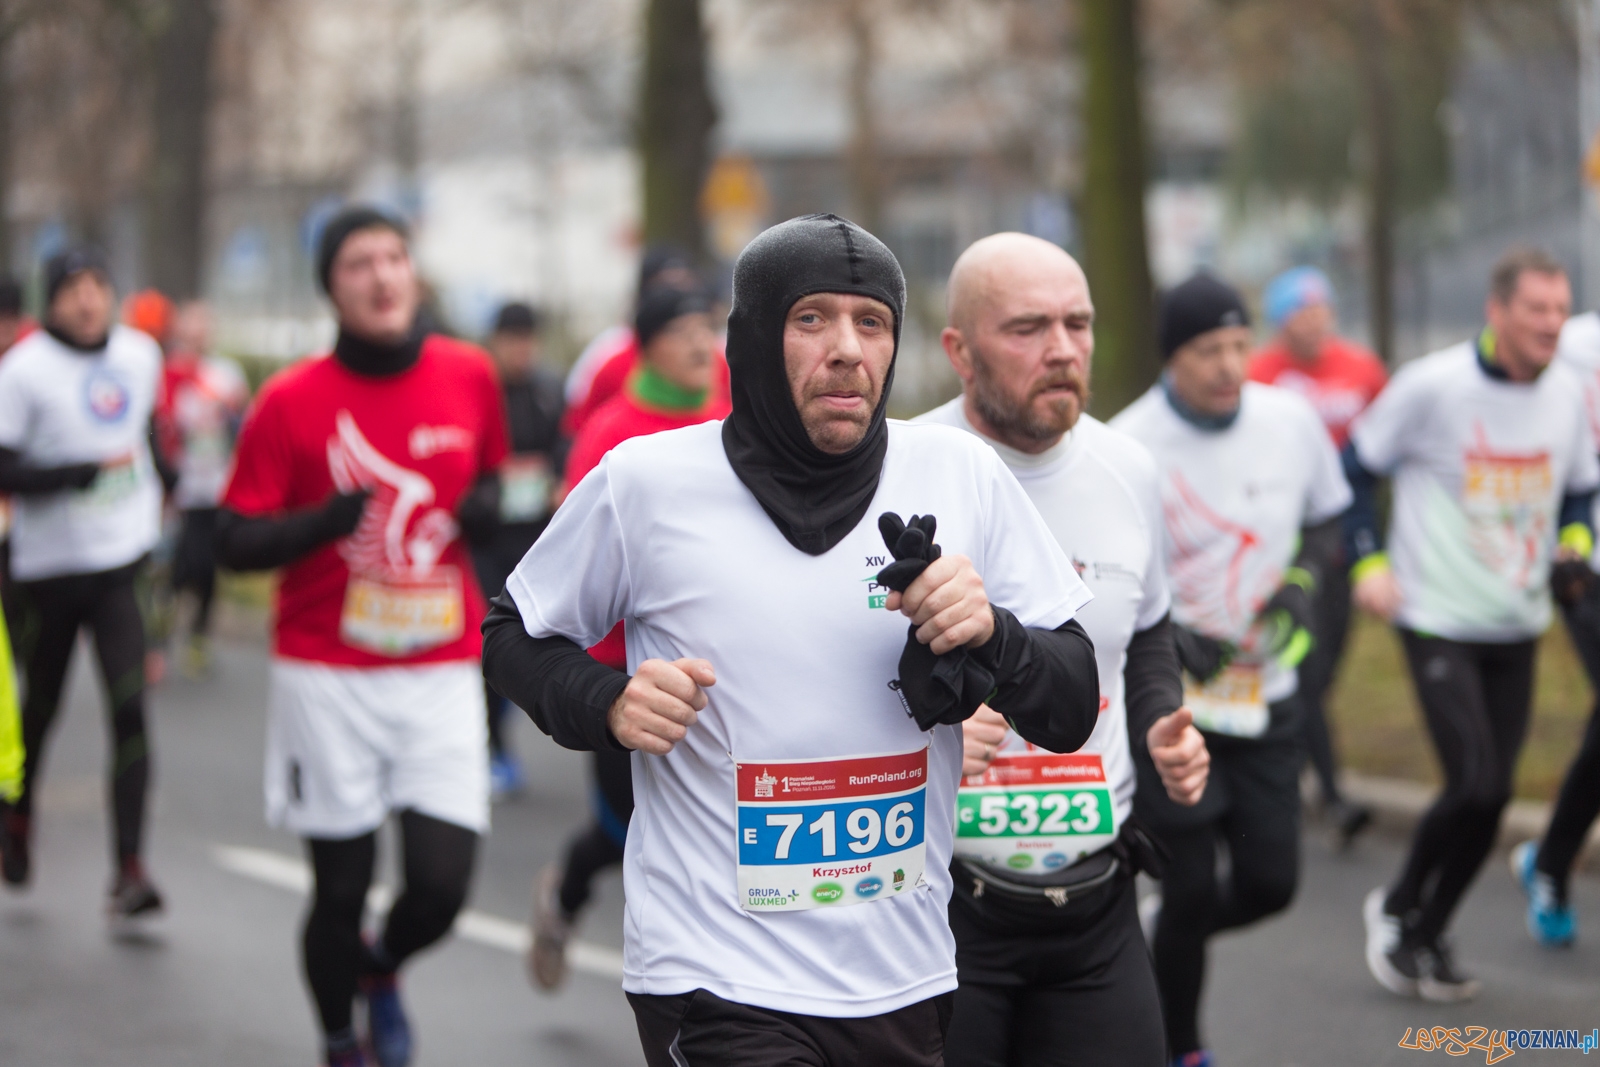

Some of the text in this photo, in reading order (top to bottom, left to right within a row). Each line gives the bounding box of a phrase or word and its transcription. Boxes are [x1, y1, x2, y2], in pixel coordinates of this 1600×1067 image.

[865, 556, 886, 567] XIV
[849, 767, 922, 785] RunPoland.org
[978, 792, 1101, 835] 5323
[743, 801, 915, 860] E 7196
[812, 862, 873, 878] Krzysztof
[748, 888, 781, 897] GRUPA
[748, 897, 787, 906] LUXMED
